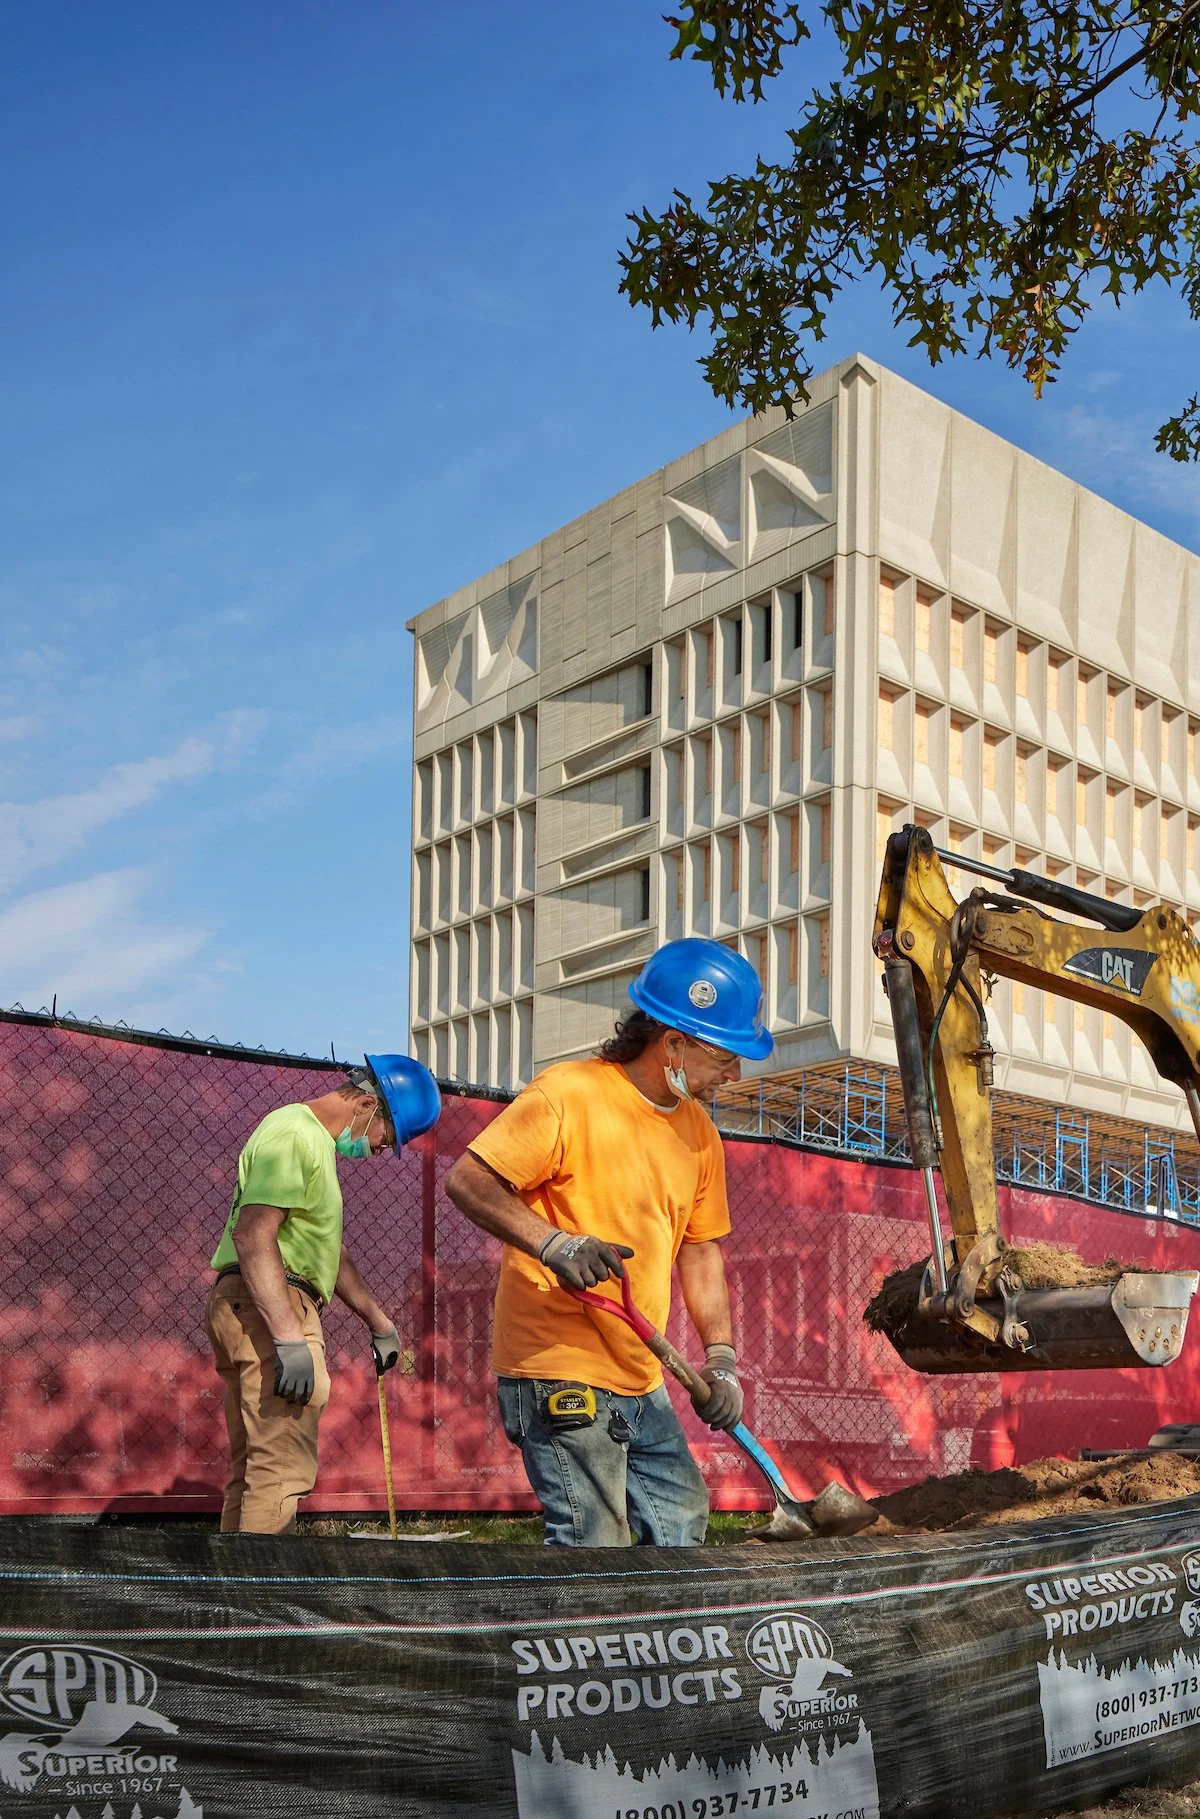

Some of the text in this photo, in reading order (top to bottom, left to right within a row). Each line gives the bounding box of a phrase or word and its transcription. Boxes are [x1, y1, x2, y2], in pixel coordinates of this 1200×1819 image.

[1101, 951, 1134, 991] CAT
[1025, 1563, 1177, 1610] SUPERIOR
[1042, 1587, 1177, 1641] PRODUCTS
[511, 1625, 734, 1675] SUPERIOR
[517, 1667, 743, 1721] PRODUCTS
[773, 1694, 859, 1720] SUPERIOR
[1096, 1693, 1135, 1722] (800)
[798, 1712, 851, 1732] Since 1967
[18, 1751, 178, 1777] SUPERIOR
[66, 1777, 163, 1796] Since 1967
[692, 1779, 809, 1819] 937-7734
